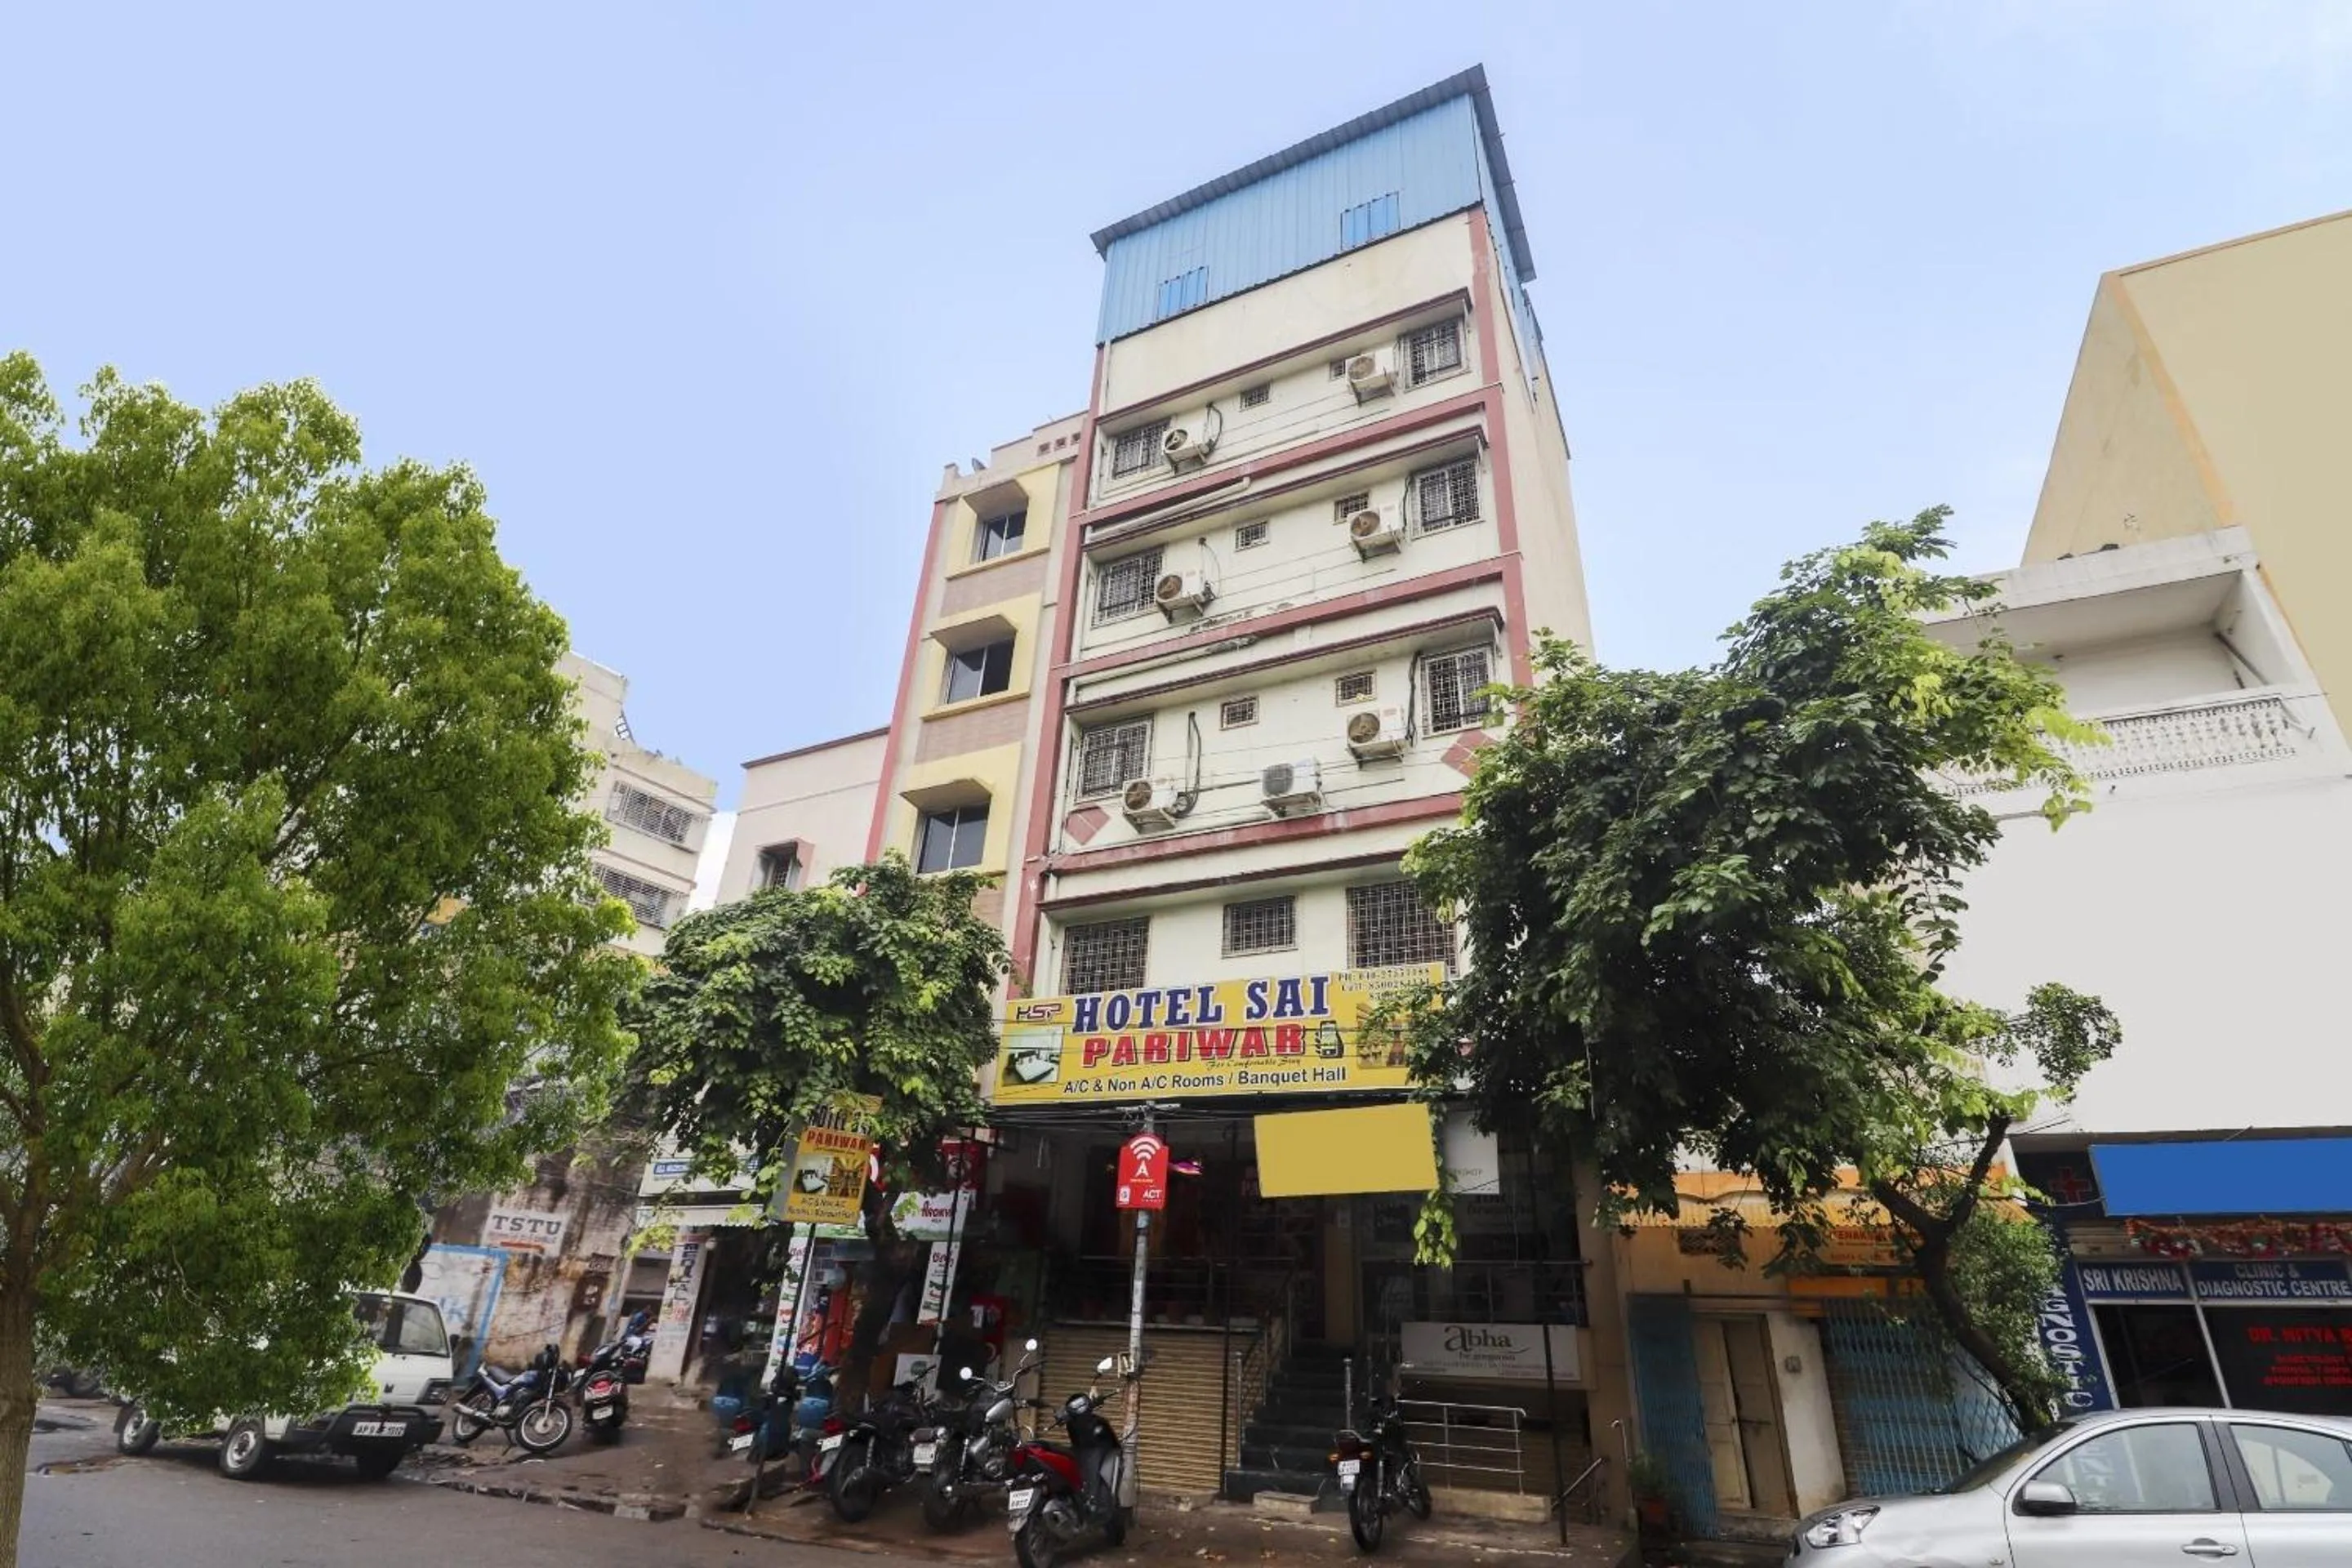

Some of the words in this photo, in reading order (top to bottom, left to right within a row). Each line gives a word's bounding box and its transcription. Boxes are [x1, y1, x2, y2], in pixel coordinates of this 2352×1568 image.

[1072, 986, 1223, 1032] HOTEL
[1246, 976, 1329, 1019] SAI
[1082, 1023, 1306, 1067] PARIWAR
[1063, 1079, 1089, 1094] A/C
[1093, 1078, 1103, 1093] &
[1107, 1078, 1136, 1092] Non
[1141, 1076, 1168, 1090] A/C
[1172, 1071, 1224, 1088] Rooms
[1238, 1069, 1307, 1087] Banquet
[1312, 1067, 1347, 1082] Hall
[806, 1130, 866, 1151] PARIWAR
[1143, 1189, 1163, 1199] ACT
[492, 1214, 562, 1236] TSTU
[2083, 1268, 2111, 1291] SRI
[2111, 1267, 2185, 1292] KRISHNA
[2234, 1263, 2287, 1279] CLINIC
[2197, 1280, 2287, 1297] DIAGNOSTIC
[2290, 1280, 2351, 1296] CENTRE
